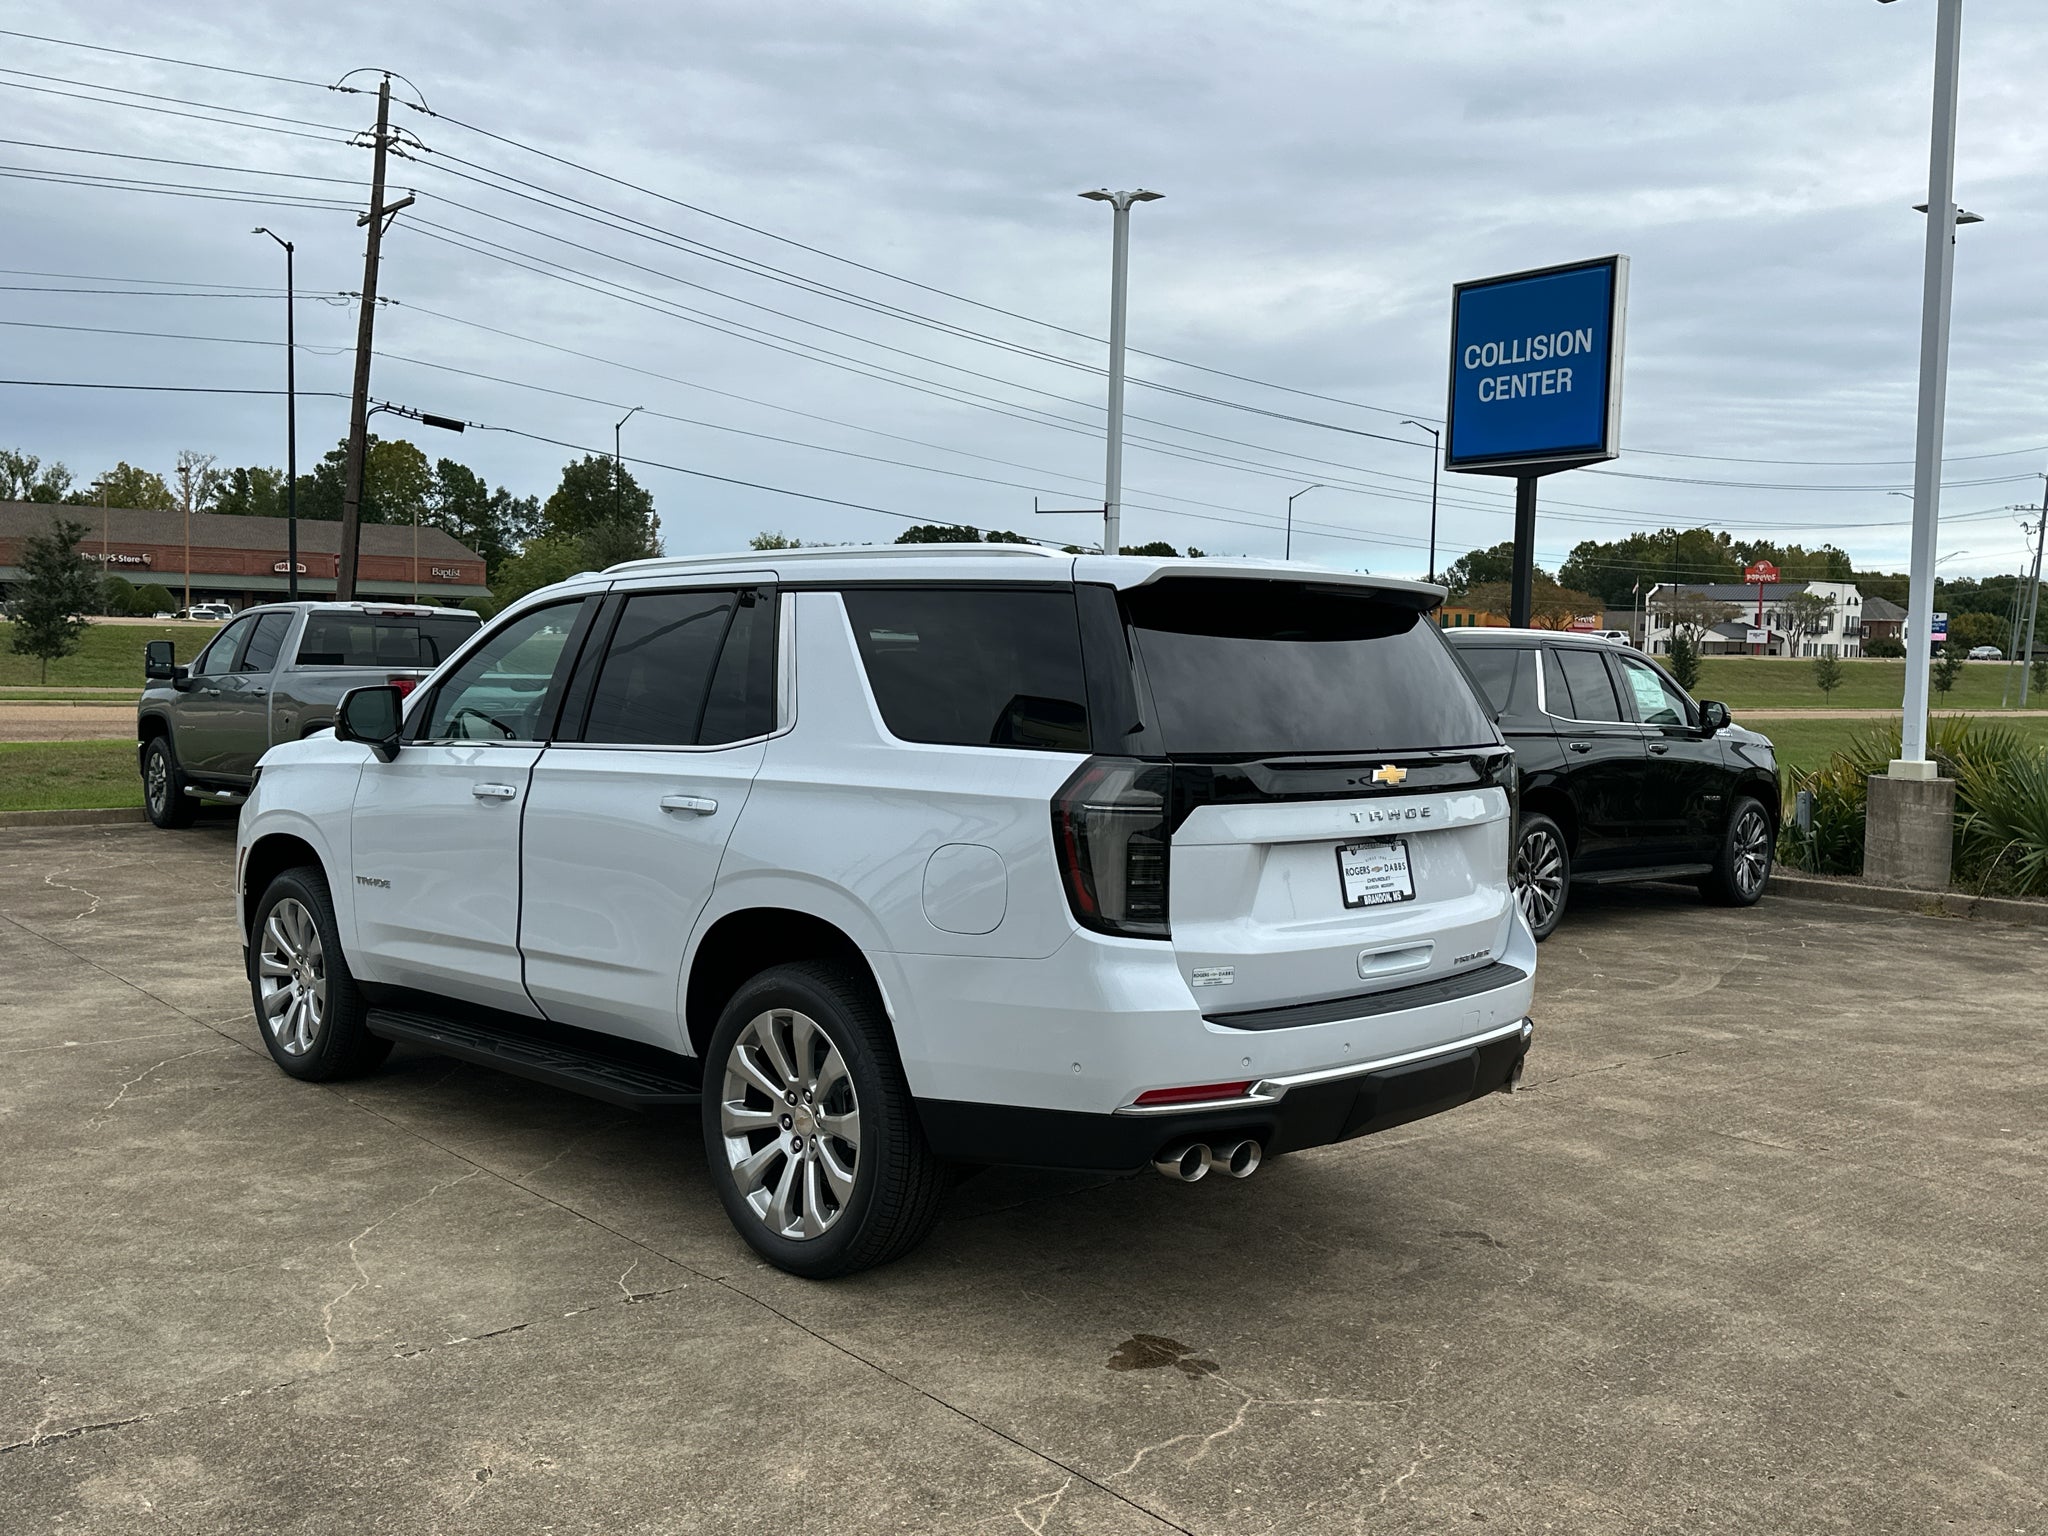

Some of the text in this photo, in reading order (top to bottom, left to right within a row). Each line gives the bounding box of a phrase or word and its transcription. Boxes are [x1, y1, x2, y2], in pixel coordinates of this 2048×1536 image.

[1464, 327, 1593, 370] COLLISION
[1478, 367, 1573, 403] CENTER
[99, 553, 116, 562] UPS
[118, 554, 141, 564] Store
[432, 567, 461, 579] Baptist
[1350, 806, 1432, 824] TAHOE
[1345, 861, 1407, 877] ROGERS DABBS
[1363, 891, 1393, 906] BRANDON,
